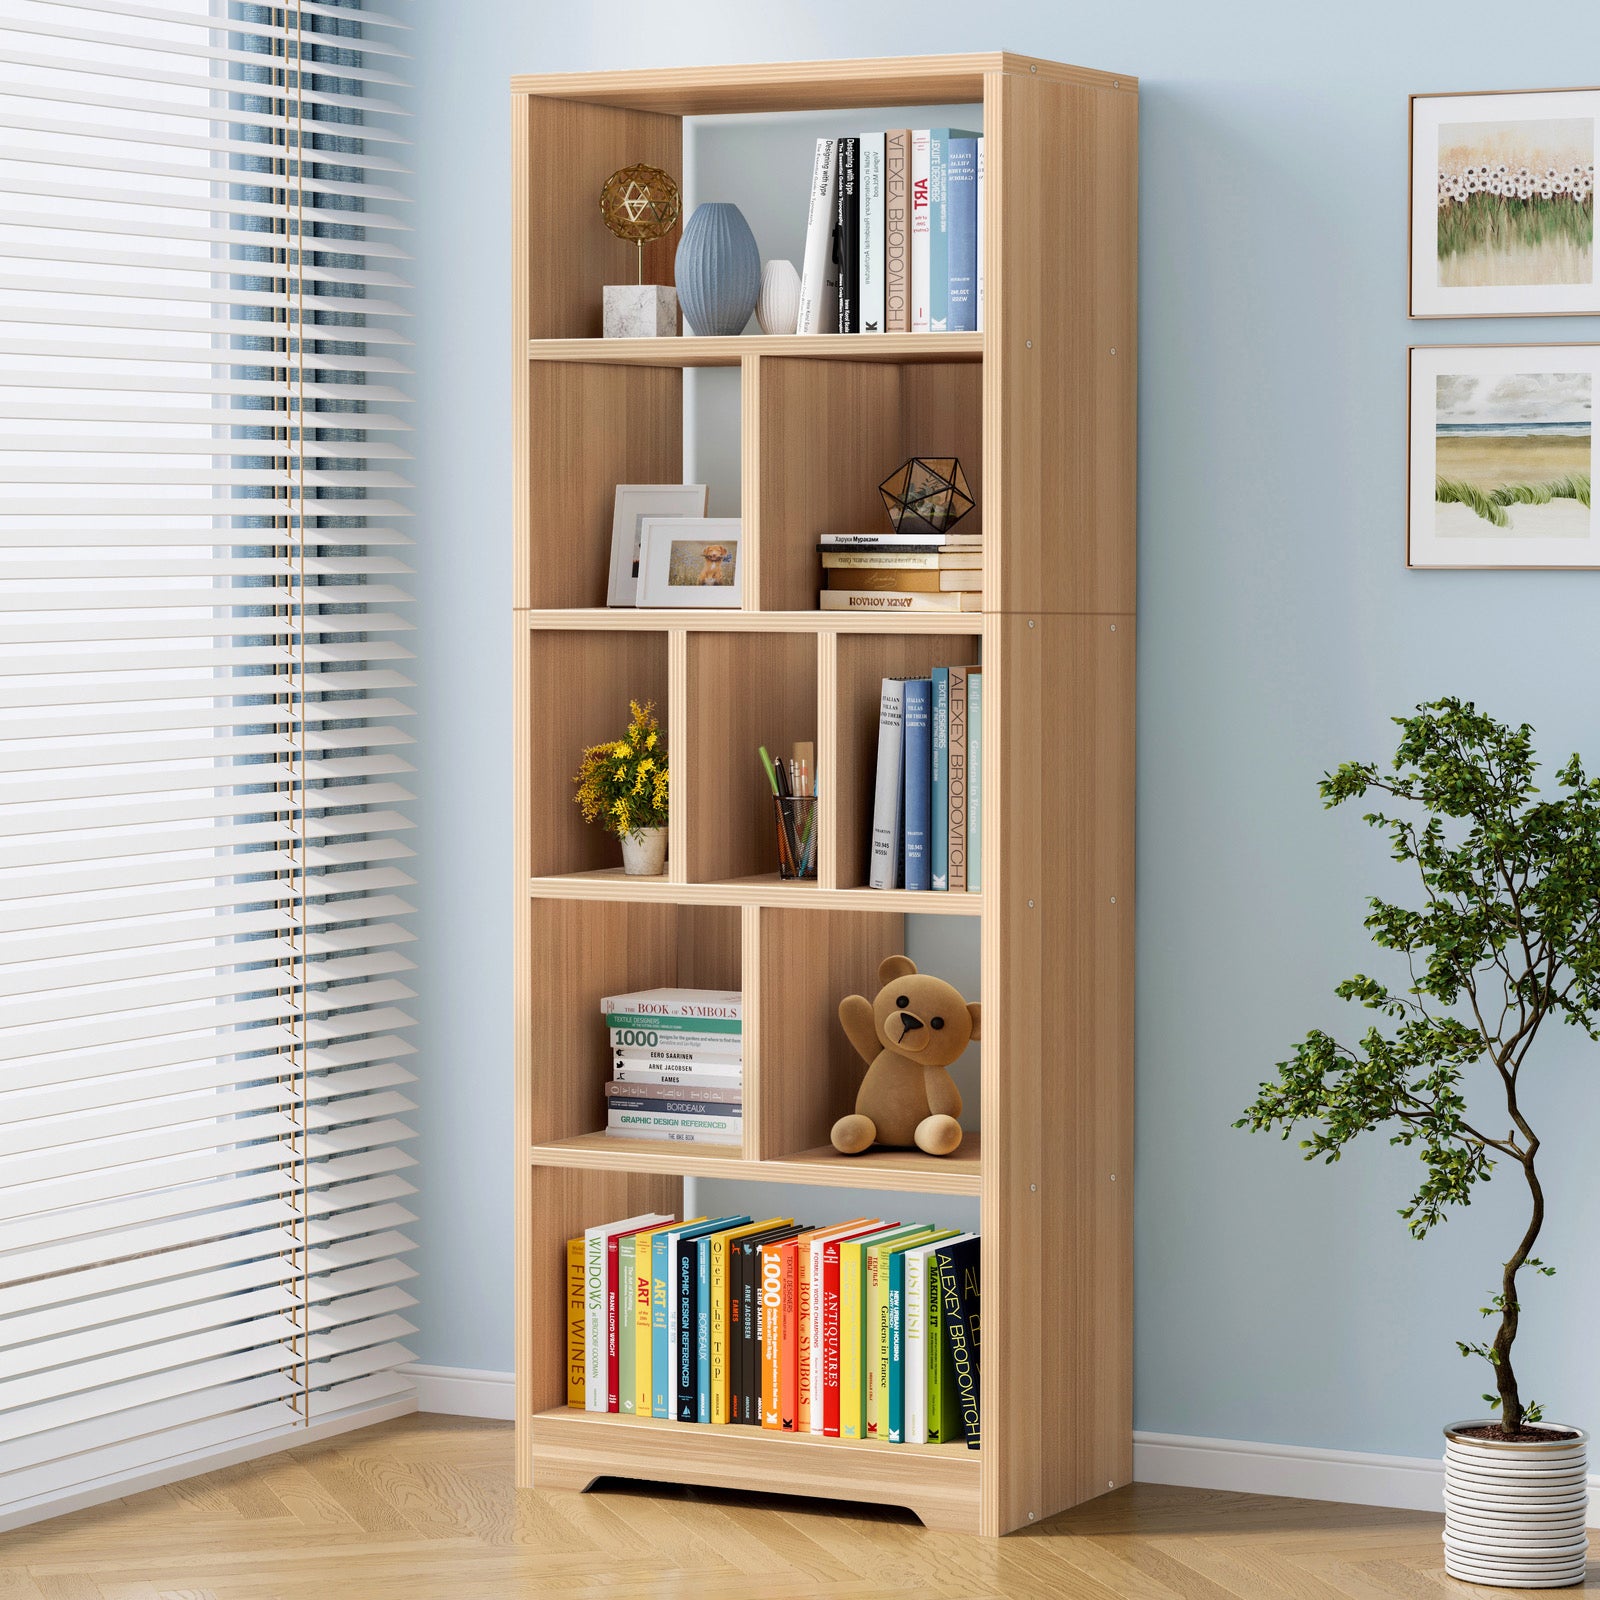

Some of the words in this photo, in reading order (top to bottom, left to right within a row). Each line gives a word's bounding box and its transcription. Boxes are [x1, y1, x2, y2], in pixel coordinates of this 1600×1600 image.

[822, 140, 834, 169] Designing
[846, 138, 854, 168] Designing
[820, 184, 828, 196] type
[846, 182, 854, 195] type
[850, 597, 885, 607] ЛОНДОН
[887, 598, 913, 607] ДЖЕК
[951, 673, 964, 748] ALEXEY
[970, 740, 979, 782] Gardens
[970, 786, 978, 796] in
[950, 754, 964, 878] BRODOVITCH
[970, 799, 978, 834] France
[638, 1003, 669, 1014] BOOK
[681, 1006, 737, 1018] SYMBOLS
[616, 1030, 658, 1047] 1000
[621, 1116, 652, 1124] GRAPHIC
[653, 1118, 679, 1126] DESIGN
[681, 1120, 727, 1129] REFERENCED
[666, 1103, 706, 1113] BORDEAUX
[589, 1237, 602, 1310] WINDOWS
[714, 1242, 722, 1285] Over
[908, 1257, 919, 1297] LOST
[572, 1264, 584, 1309] FINE
[638, 1277, 649, 1306] ART
[654, 1278, 666, 1308] ART
[764, 1253, 780, 1307] 1000
[800, 1282, 810, 1320] BOOK
[908, 1303, 919, 1339] FISH
[930, 1315, 938, 1328] IT
[572, 1320, 585, 1386] WINES
[828, 1292, 838, 1387] ANTIQUAIRES
[881, 1346, 888, 1354] in
[938, 1254, 961, 1319] ALEXEY
[950, 1325, 980, 1435] BRODOVITCH
[800, 1336, 810, 1405] SYMBOLS
